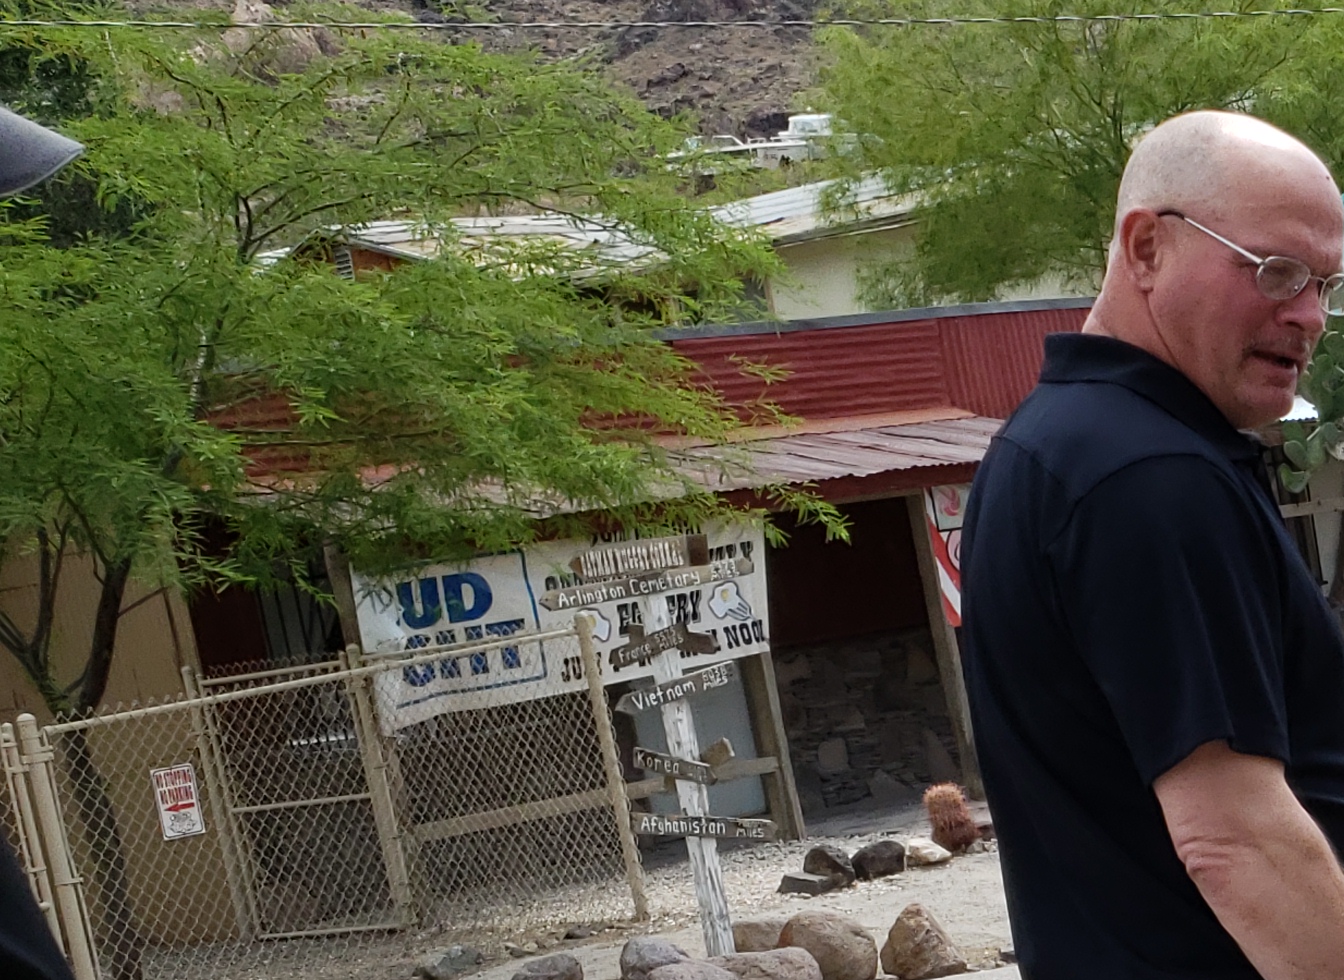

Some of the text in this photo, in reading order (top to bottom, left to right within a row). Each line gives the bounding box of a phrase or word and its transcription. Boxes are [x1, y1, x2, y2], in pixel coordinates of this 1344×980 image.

[396, 571, 493, 629] UD
[558, 582, 626, 609] Arlington
[616, 590, 701, 637] EAERY
[631, 680, 696, 710] Vietnam
[636, 752, 680, 773] Korea
[641, 816, 726, 835] Afghanistan
